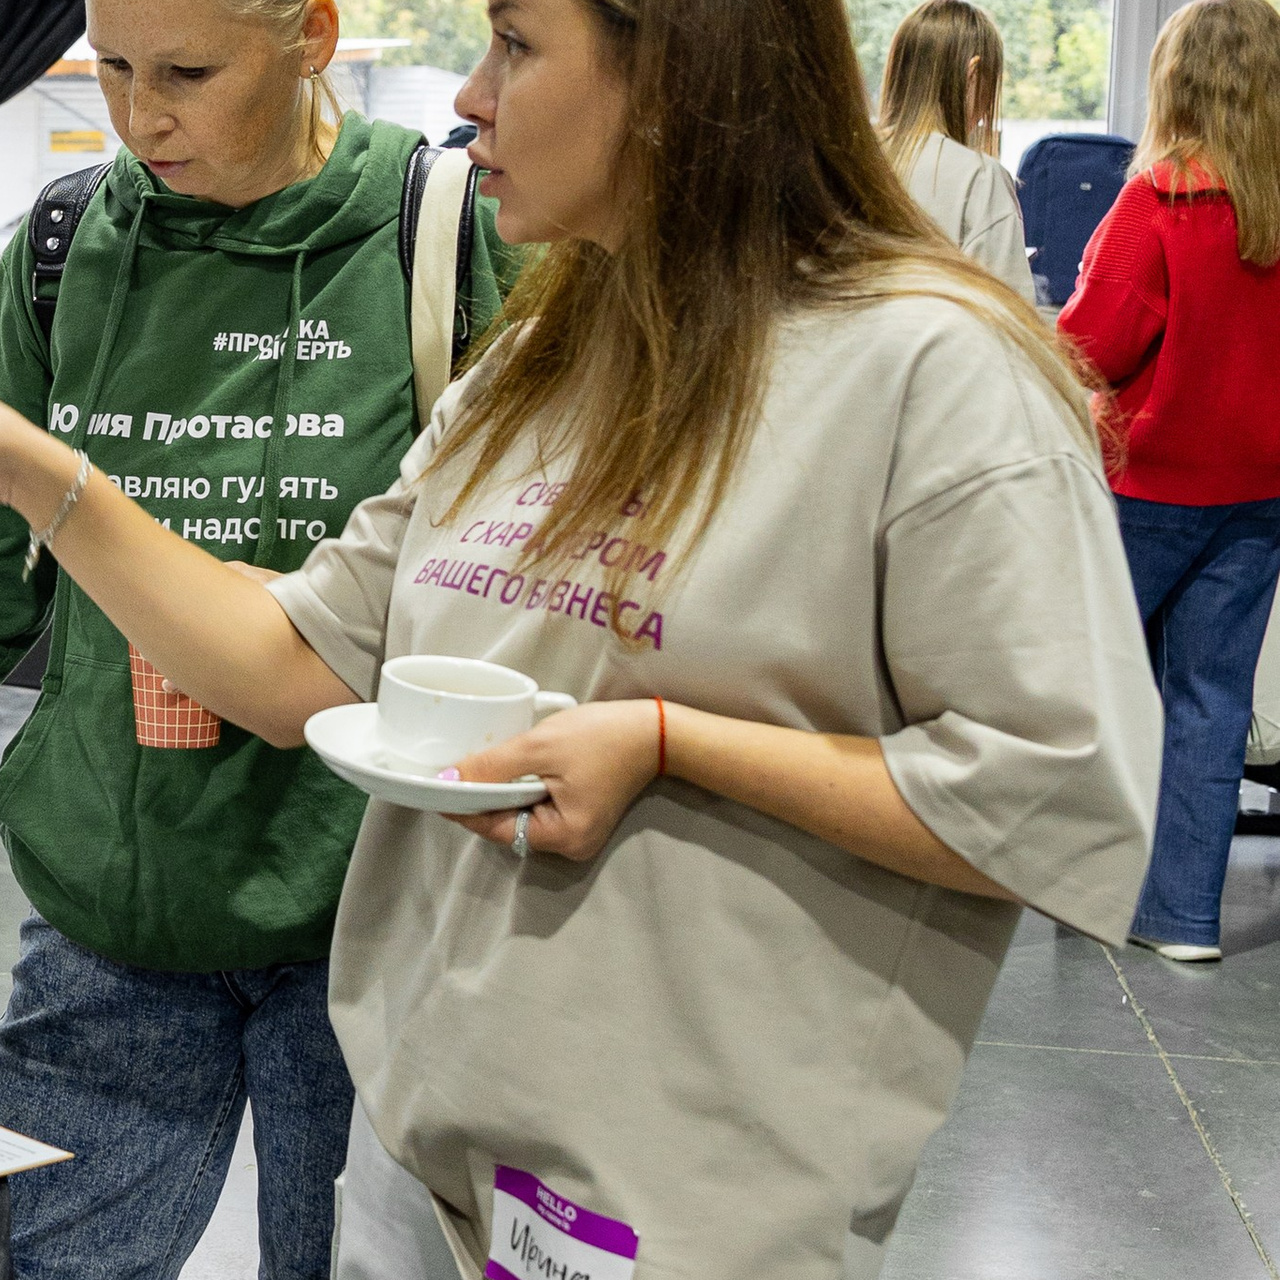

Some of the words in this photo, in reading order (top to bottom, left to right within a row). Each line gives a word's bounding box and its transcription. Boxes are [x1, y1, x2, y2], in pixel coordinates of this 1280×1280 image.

[50, 403, 133, 438] Юия
[414, 558, 525, 605] ВАШЕГО
[525, 579, 663, 651] БИЗНЕСА
[536, 1185, 578, 1222] HELLO
